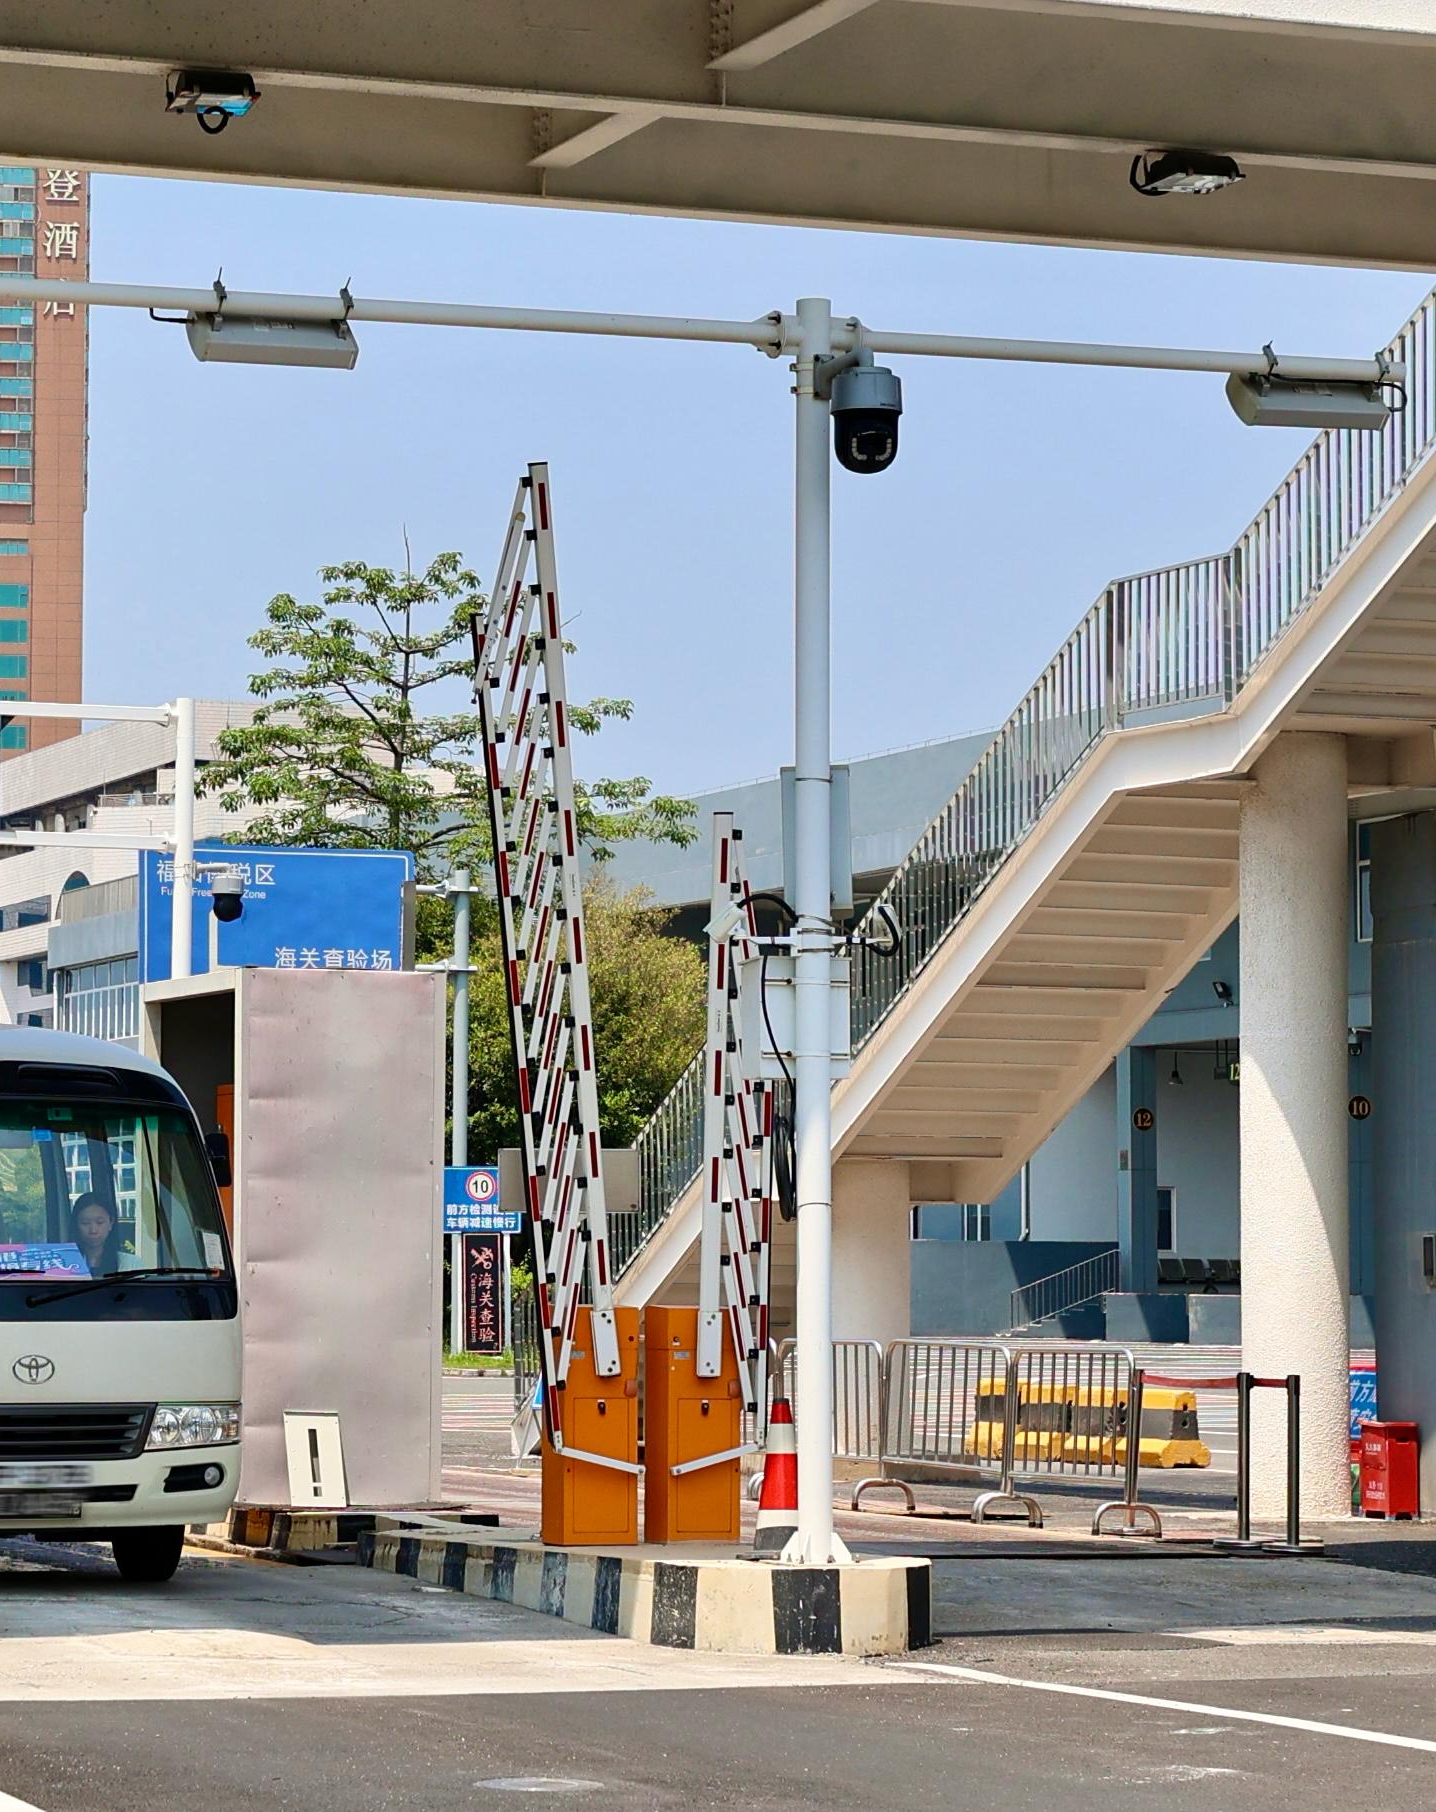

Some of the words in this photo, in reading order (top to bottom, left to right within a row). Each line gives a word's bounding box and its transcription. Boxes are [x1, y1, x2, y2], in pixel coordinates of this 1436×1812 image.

[157, 860, 276, 885] 福税区
[243, 889, 267, 900] Zone
[275, 946, 393, 970] 海关查验场
[1351, 1102, 1369, 1116] 10
[1136, 1113, 1151, 1127] 12
[472, 1180, 489, 1194] 10
[446, 1217, 517, 1229] 车辆减速慢行
[478, 1272, 496, 1343] 海关查验
